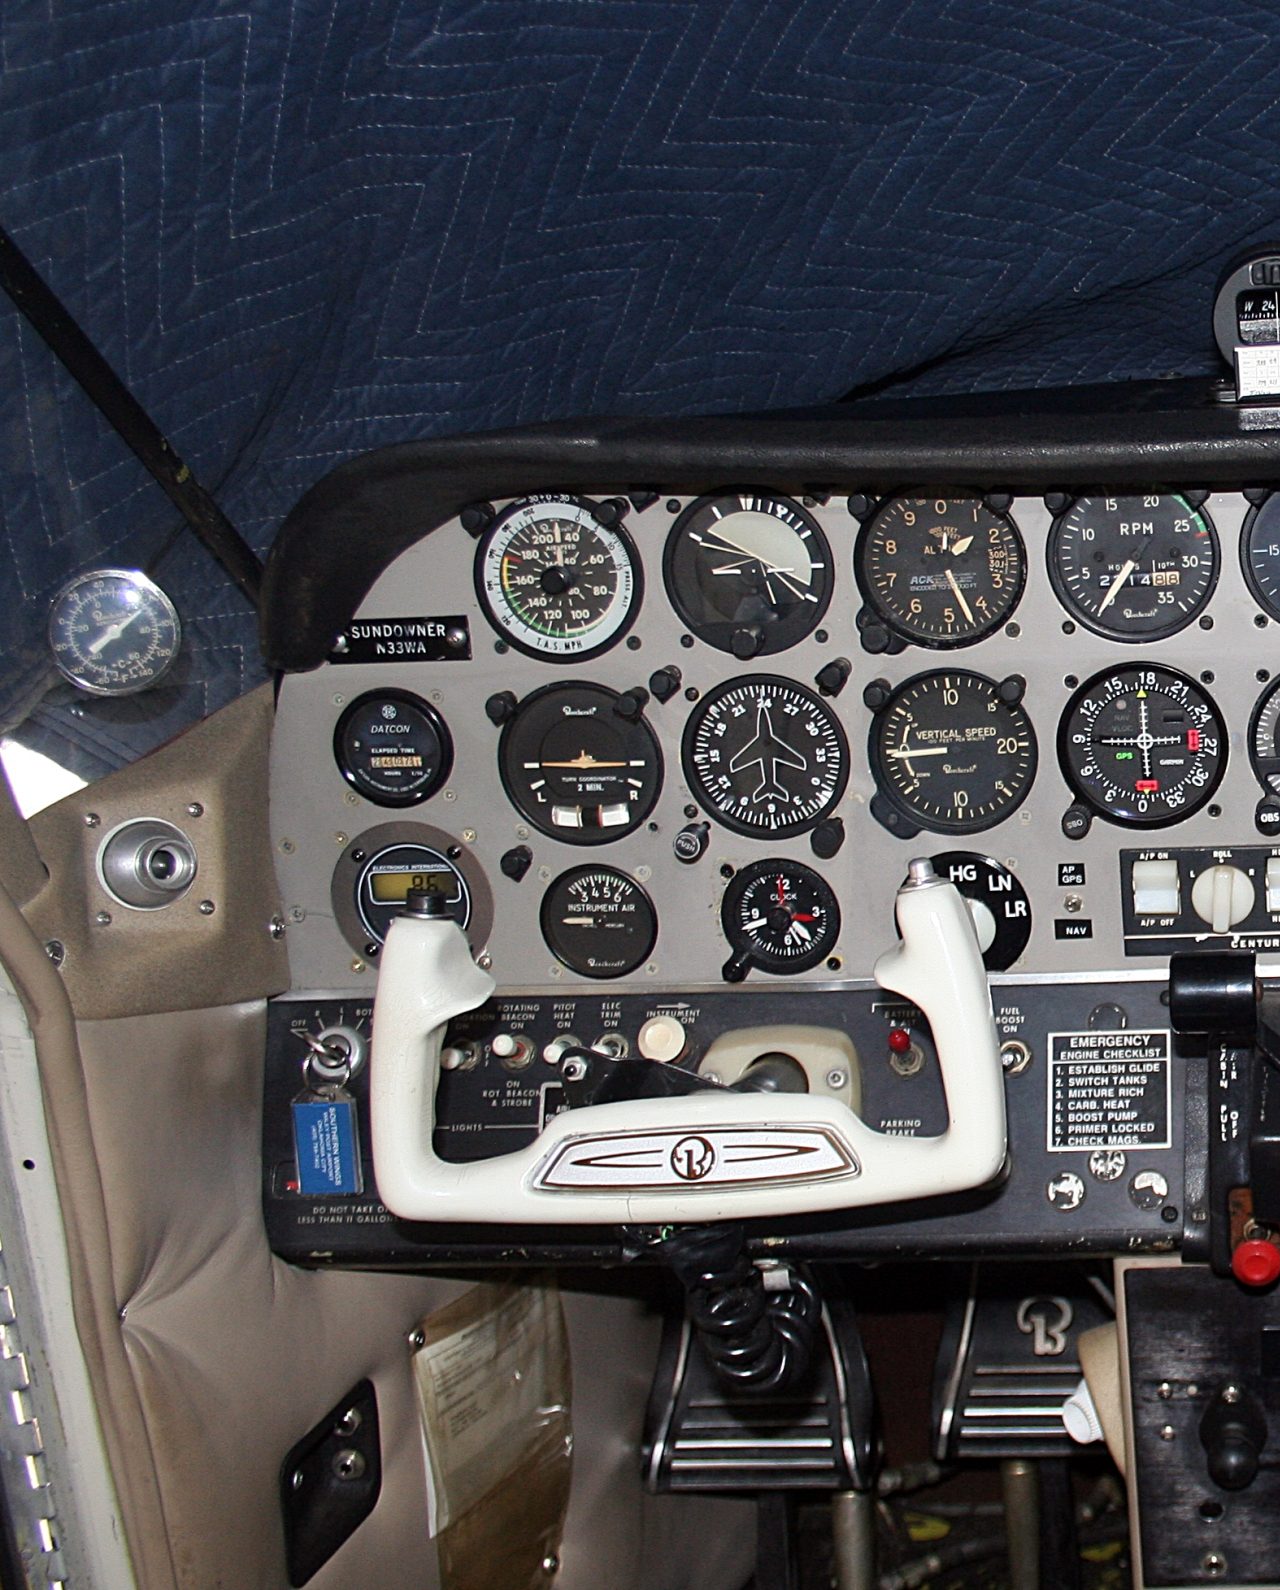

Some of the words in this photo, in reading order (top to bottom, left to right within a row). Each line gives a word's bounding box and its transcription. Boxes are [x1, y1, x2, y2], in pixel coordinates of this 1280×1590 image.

[1244, 302, 1253, 312] W
[1262, 301, 1275, 311] 24
[1120, 523, 1153, 535] RPM
[1174, 520, 1190, 532] 25
[532, 534, 553, 544] 200
[1082, 529, 1094, 541] 10
[521, 551, 539, 560] 180
[1182, 556, 1198, 567] 30
[528, 598, 547, 607] 140
[1158, 592, 1174, 604] 35
[544, 610, 562, 619] 120
[352, 625, 445, 638] SUNDOWNER
[377, 642, 426, 654] N33WA
[371, 725, 410, 733] DATCON
[916, 730, 960, 740] VERTICAL
[966, 727, 996, 737] SPEED
[997, 738, 1017, 754] 20
[1261, 813, 1280, 822] OBS
[950, 864, 976, 882] HG
[989, 874, 1012, 891] LN
[1062, 875, 1082, 883] GPS
[568, 904, 618, 912] INSTRUMENT
[1005, 900, 1026, 918] LR
[1066, 927, 1086, 935] NAV
[1070, 1036, 1150, 1048] EMERGENCY
[1060, 1051, 1099, 1060] ENGINE
[1104, 1049, 1160, 1058] CHECKLIST
[1057, 1067, 1064, 1075] 1.
[1068, 1065, 1125, 1075] ESTABLISH
[1129, 1064, 1160, 1072] GLIDE
[1055, 1079, 1064, 1087] 2.
[1068, 1078, 1109, 1086] SWITCH
[1113, 1076, 1147, 1085] TANKS
[1055, 1091, 1063, 1099] 3.
[1069, 1089, 1114, 1097] MIXTURE
[1119, 1088, 1144, 1096] RICH
[1055, 1103, 1064, 1111] 4.
[1068, 1101, 1100, 1109] CARB.
[1103, 1100, 1130, 1109] HEAT
[1055, 1115, 1063, 1123] 5.
[1068, 1113, 1104, 1122] BOOST
[1108, 1112, 1138, 1120] PUMP
[329, 1107, 339, 1155] SOUTHERN
[452, 1124, 482, 1132] LIGHTS
[1068, 1125, 1108, 1134] PRIMER
[1112, 1123, 1154, 1132] LOCKED
[1055, 1138, 1064, 1146] 7.
[1068, 1137, 1104, 1146] CHECK
[1108, 1135, 1141, 1144] MAGS.
